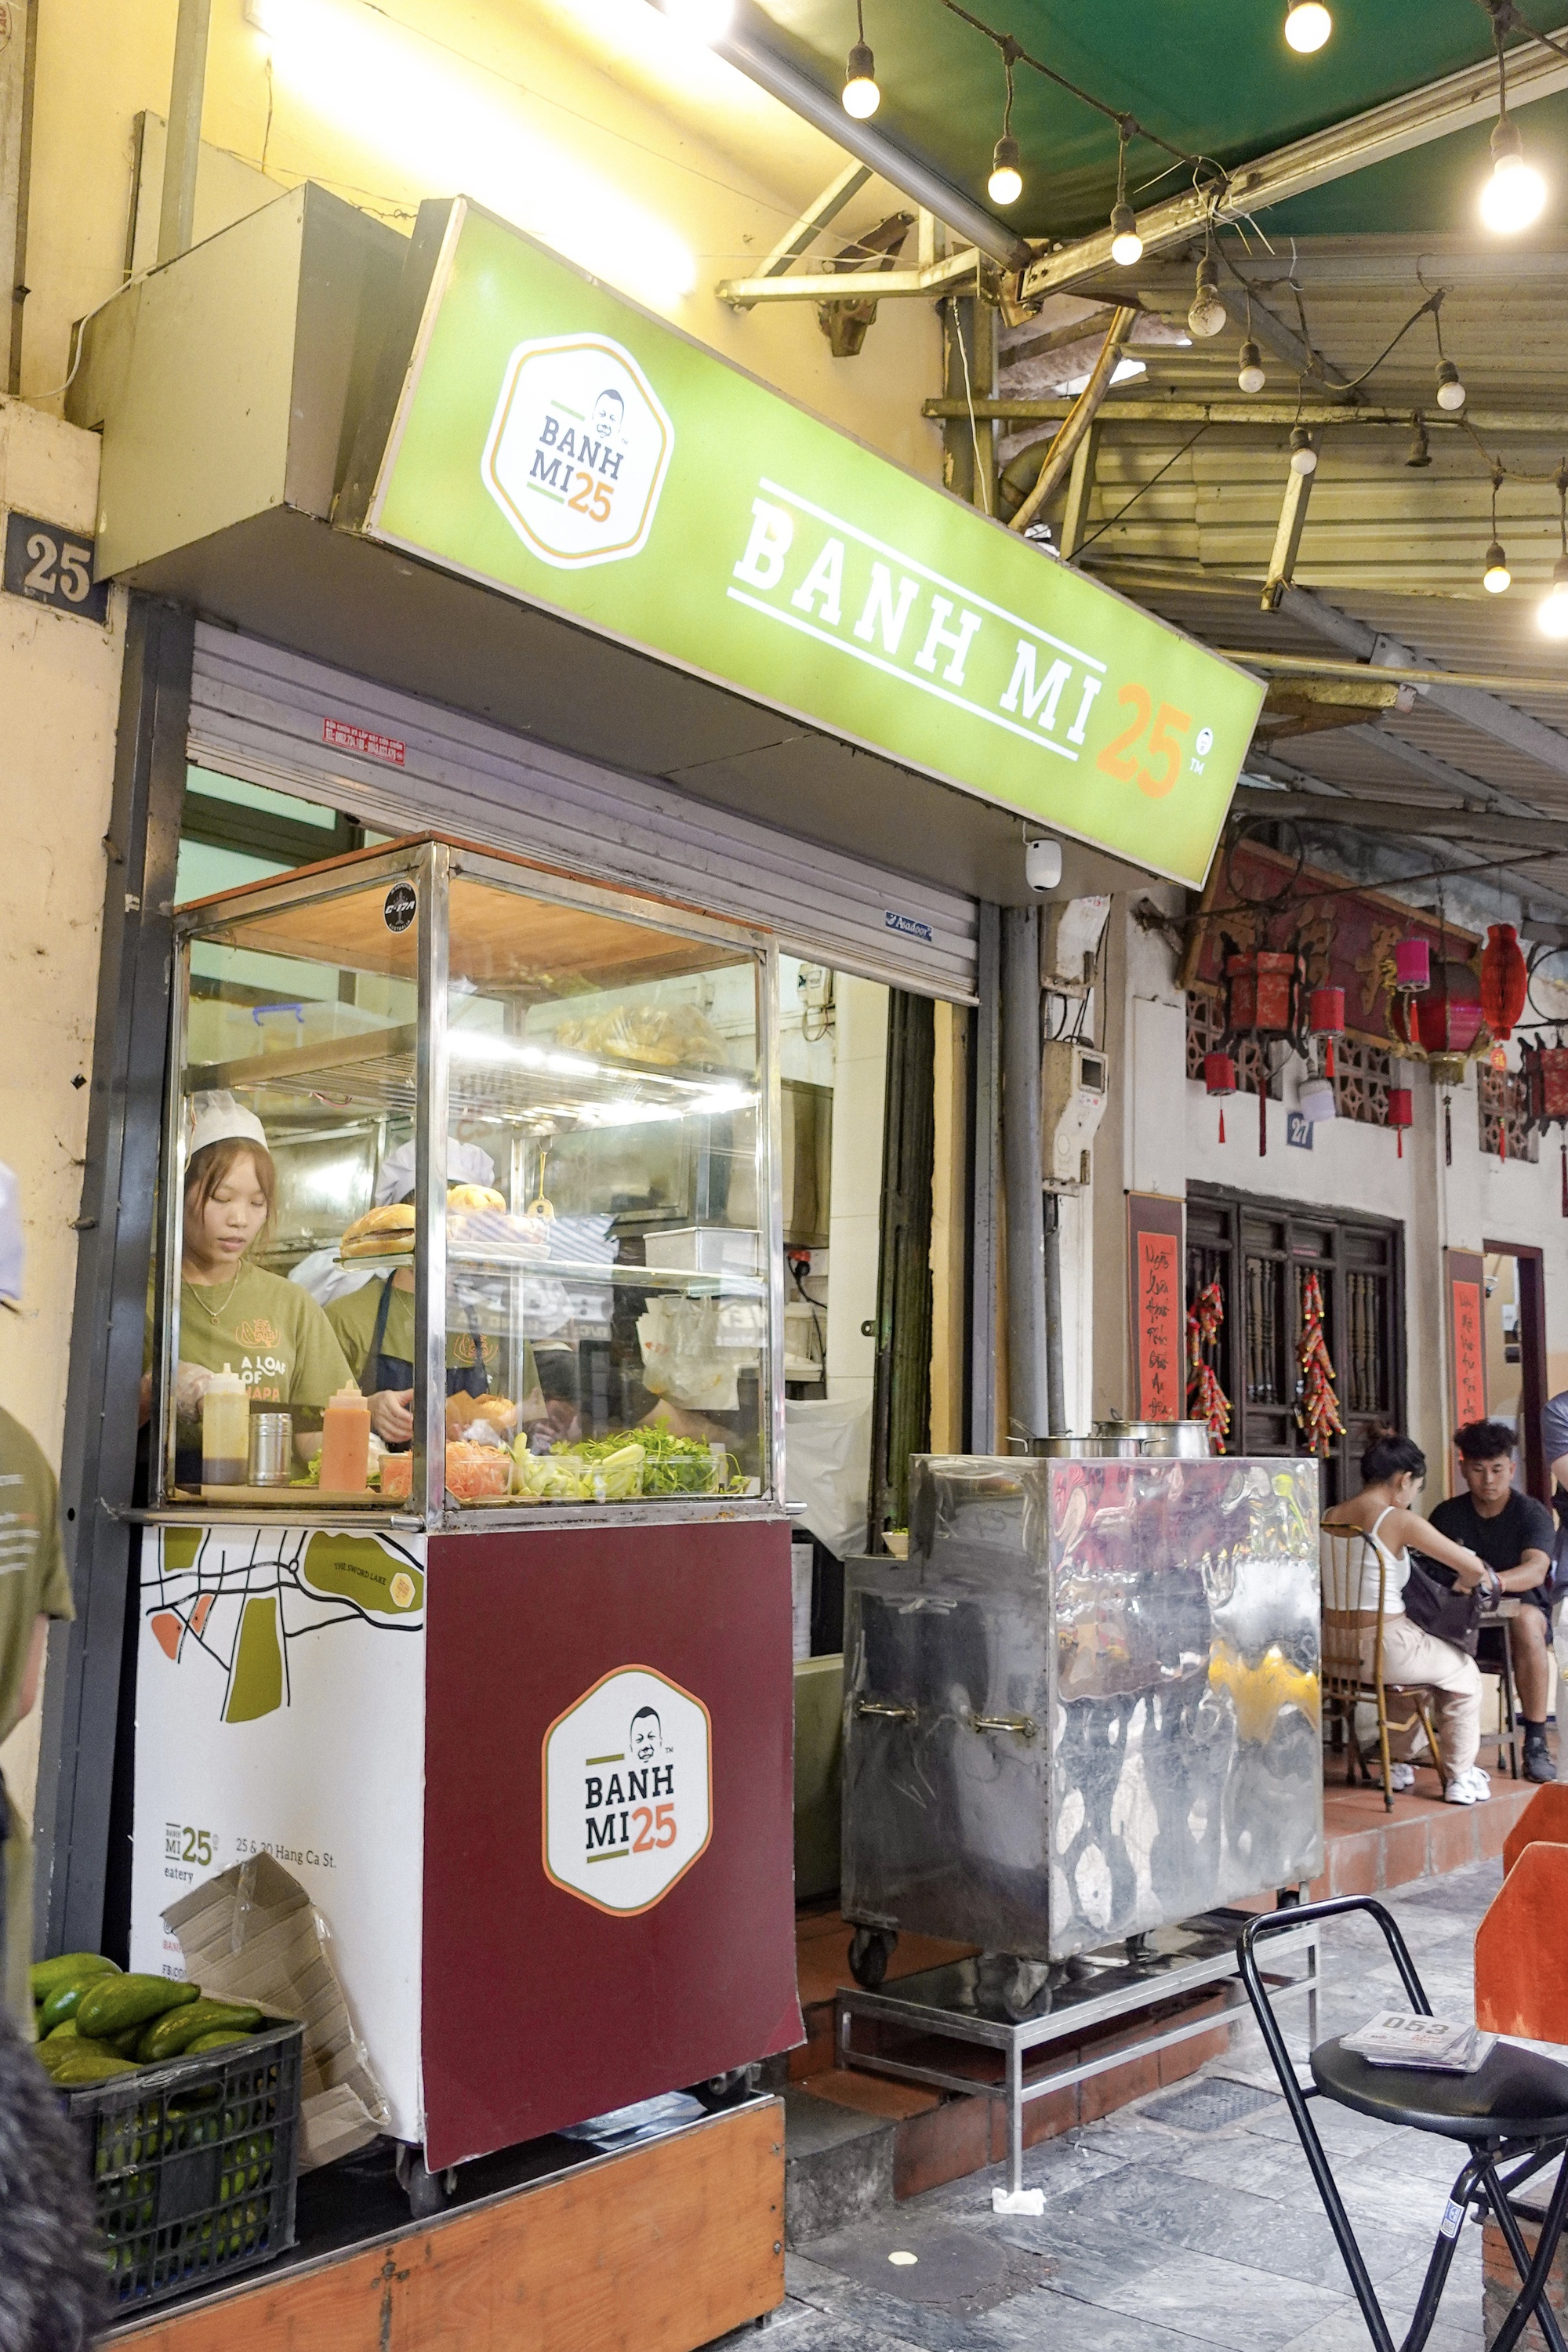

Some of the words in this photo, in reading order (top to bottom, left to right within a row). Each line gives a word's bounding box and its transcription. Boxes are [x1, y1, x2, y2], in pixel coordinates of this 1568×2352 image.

[539, 416, 624, 481] BANH
[24, 533, 91, 603] 25
[732, 497, 982, 687] BANH
[999, 639, 1102, 745] MI
[1096, 683, 1192, 799] 25
[384, 900, 416, 915] C-17A
[1291, 1117, 1310, 1145] 27
[241, 1356, 252, 1369] A
[241, 1370, 263, 1385] OF
[347, 1564, 369, 1578] SWORD
[370, 1572, 387, 1585] LAKE
[585, 1764, 674, 1809] BANH
[165, 1838, 181, 1854] MI
[182, 1826, 212, 1866] 25
[235, 1837, 248, 1853] 25
[250, 1839, 258, 1854] &
[275, 1844, 304, 1865] Hang
[306, 1849, 320, 1865] Ca
[323, 1853, 337, 1868] St.
[165, 1867, 194, 1885] eatery
[1381, 2016, 1450, 2036] 053
